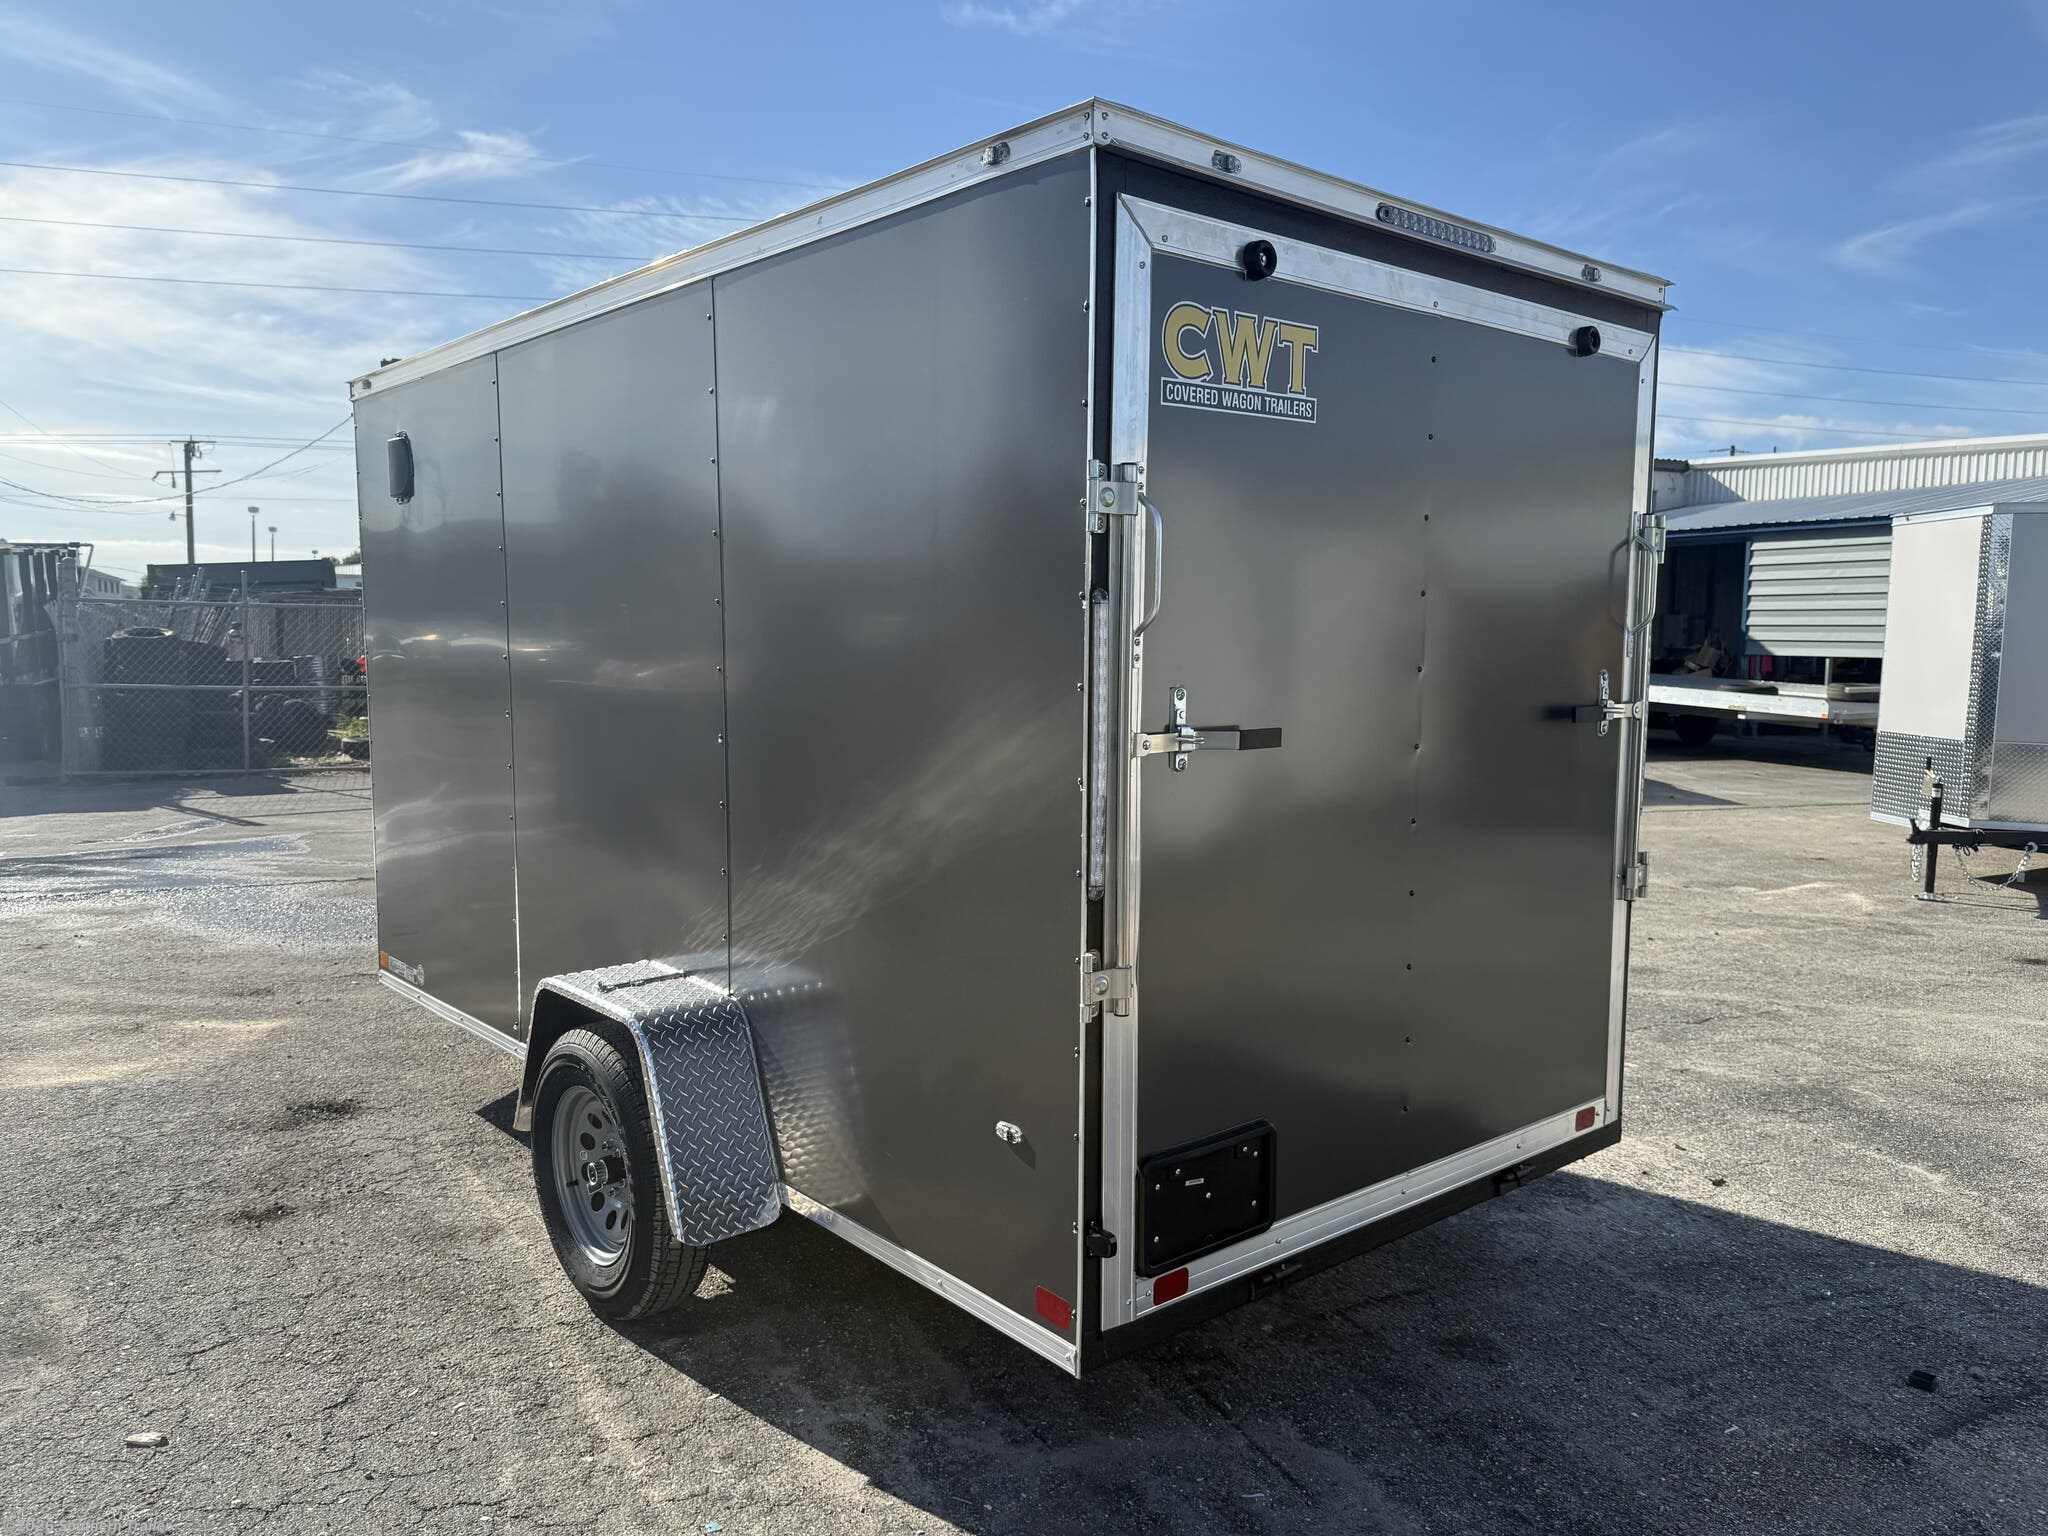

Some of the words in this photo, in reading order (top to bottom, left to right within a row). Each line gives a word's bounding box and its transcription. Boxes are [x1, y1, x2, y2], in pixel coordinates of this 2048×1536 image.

[1162, 301, 1319, 397] CWT
[1166, 383, 1218, 405] COVERED
[1221, 390, 1262, 411] WAGON
[1264, 396, 1312, 418] TRAILERS
